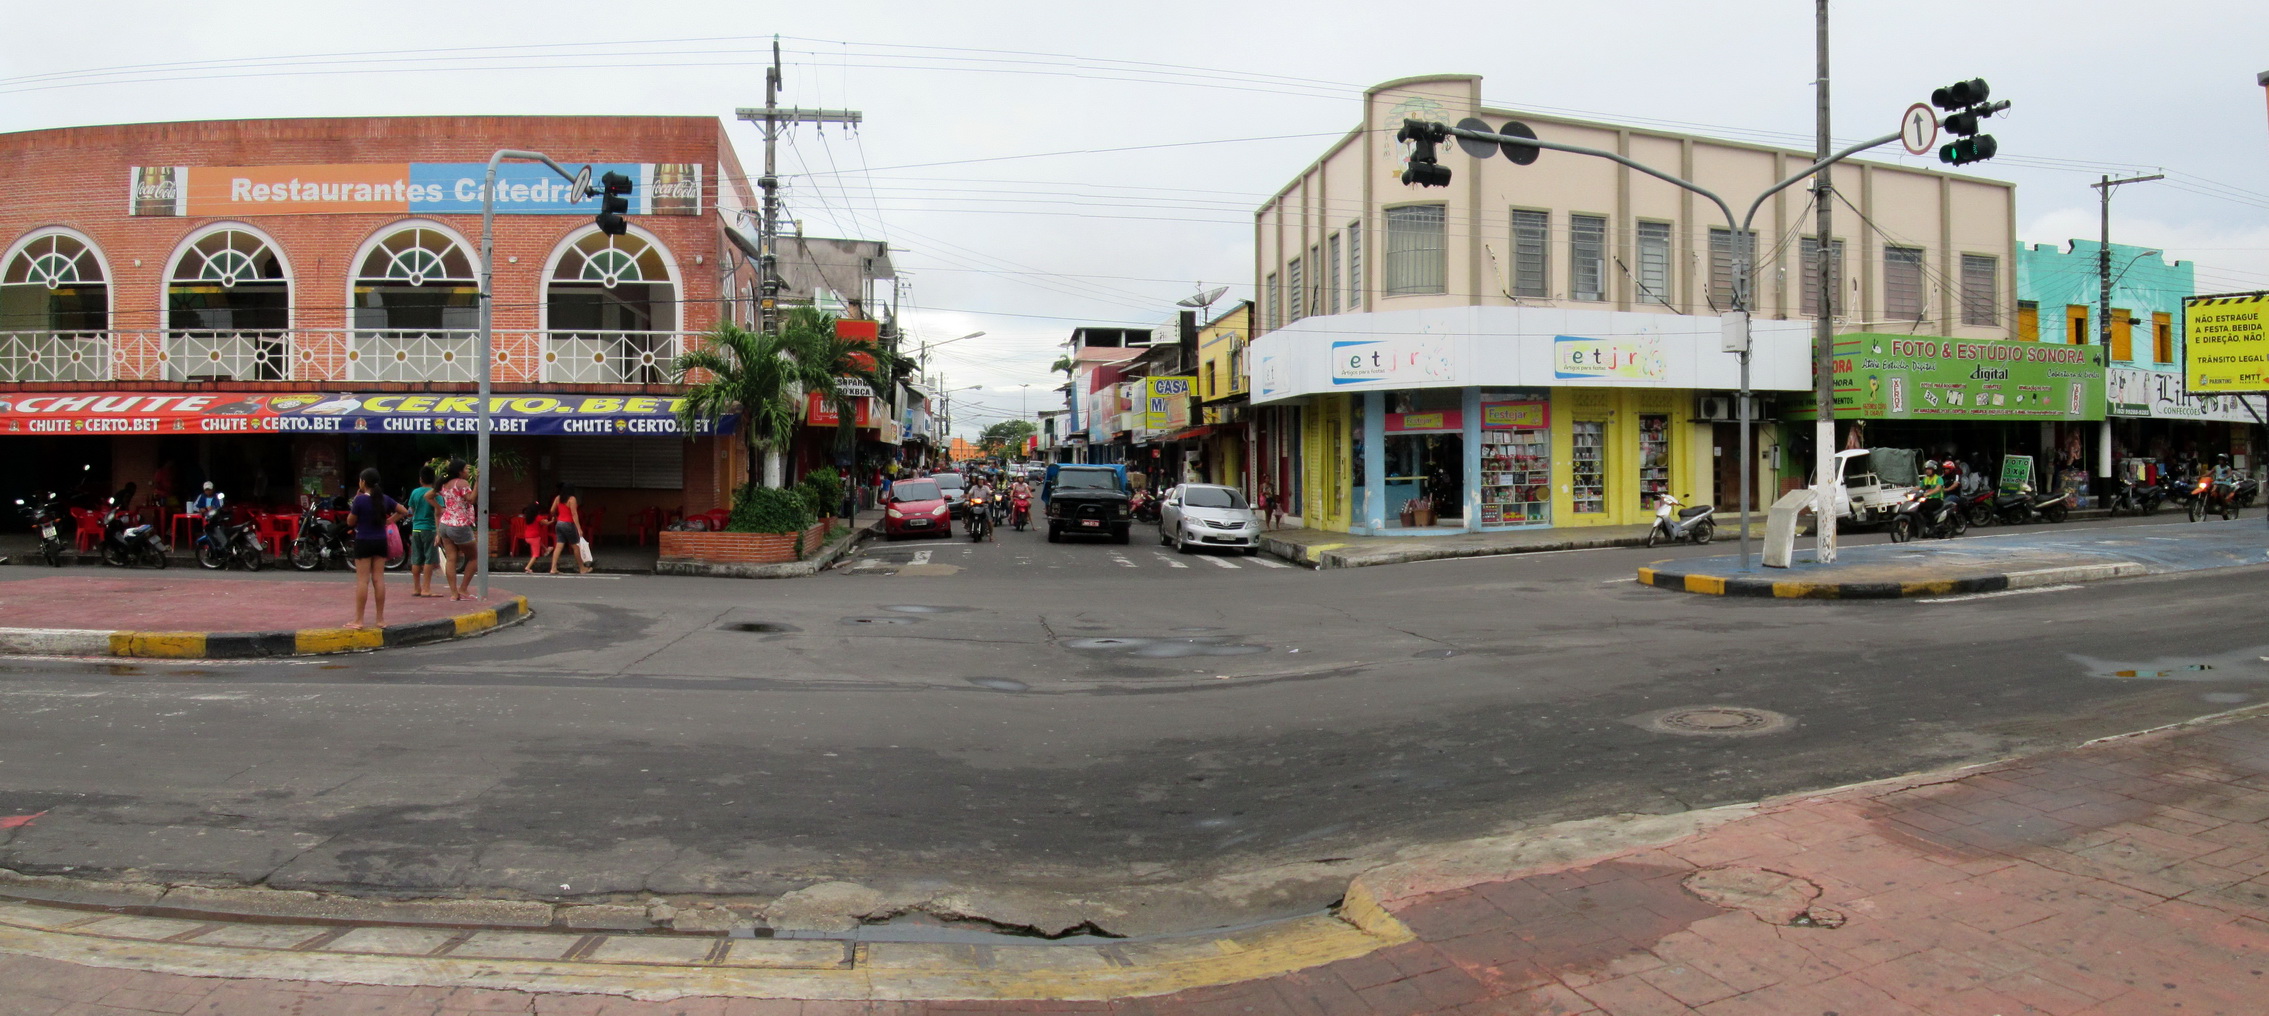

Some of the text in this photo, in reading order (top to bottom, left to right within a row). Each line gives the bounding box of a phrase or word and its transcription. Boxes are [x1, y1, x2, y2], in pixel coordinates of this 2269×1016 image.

[231, 178, 444, 203] Restaurantes
[2195, 313, 2258, 323] NÃO ESTRAGUE
[2232, 323, 2263, 332] BEBIDA
[2195, 336, 2200, 344] E
[2243, 331, 2266, 341] NÃO!
[1892, 339, 2086, 364] FOTO & ESTÚDIO SONORA
[2197, 355, 2264, 363] TRÂNSITO LEGAL
[1969, 364, 2009, 381] digital
[2240, 373, 2261, 381] EMTT
[1155, 380, 1189, 394] CASA
[1892, 379, 1901, 409] XEROX
[15, 396, 219, 414] CHUTE
[2164, 406, 2201, 417] CONFECÇÕES
[1406, 416, 1433, 425] Festejar
[1489, 409, 1528, 422] Festejar
[29, 417, 160, 432] CHUTE CERTO.BET
[201, 416, 342, 431] CHUTE CERTO.BET
[383, 417, 432, 431] CHUTE
[563, 418, 613, 433] CHUTE
